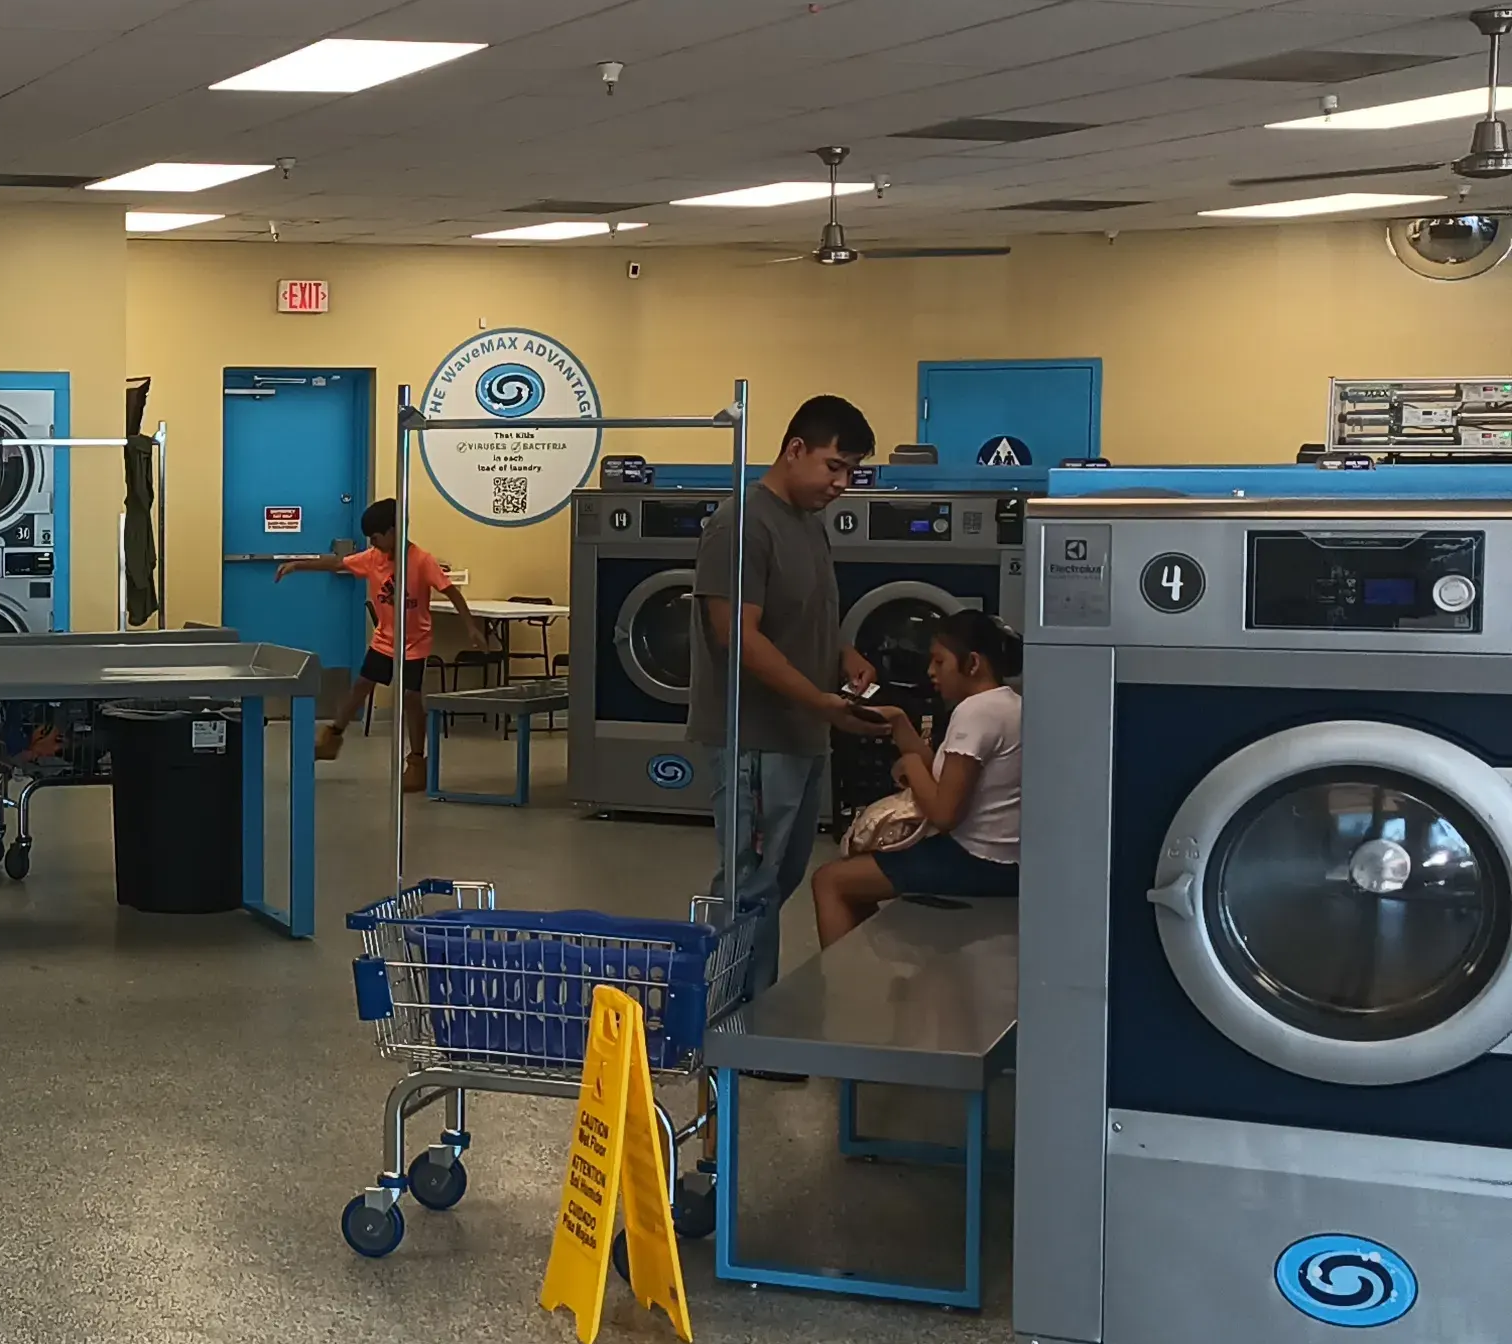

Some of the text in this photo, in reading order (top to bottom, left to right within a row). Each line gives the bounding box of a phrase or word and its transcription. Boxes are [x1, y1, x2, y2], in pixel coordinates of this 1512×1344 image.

[289, 283, 322, 308] EXIT
[429, 388, 446, 419] HE
[442, 336, 518, 383] WaveMAX
[523, 442, 567, 450] BACTERIA
[478, 464, 496, 472] load
[615, 512, 627, 527] 14
[840, 515, 854, 530] 13
[16, 527, 30, 540] 30
[1161, 565, 1184, 601] 4
[580, 1110, 609, 1139] CAUTION
[572, 1154, 606, 1188] ATTENTION
[568, 1200, 596, 1231] CUIDADO
